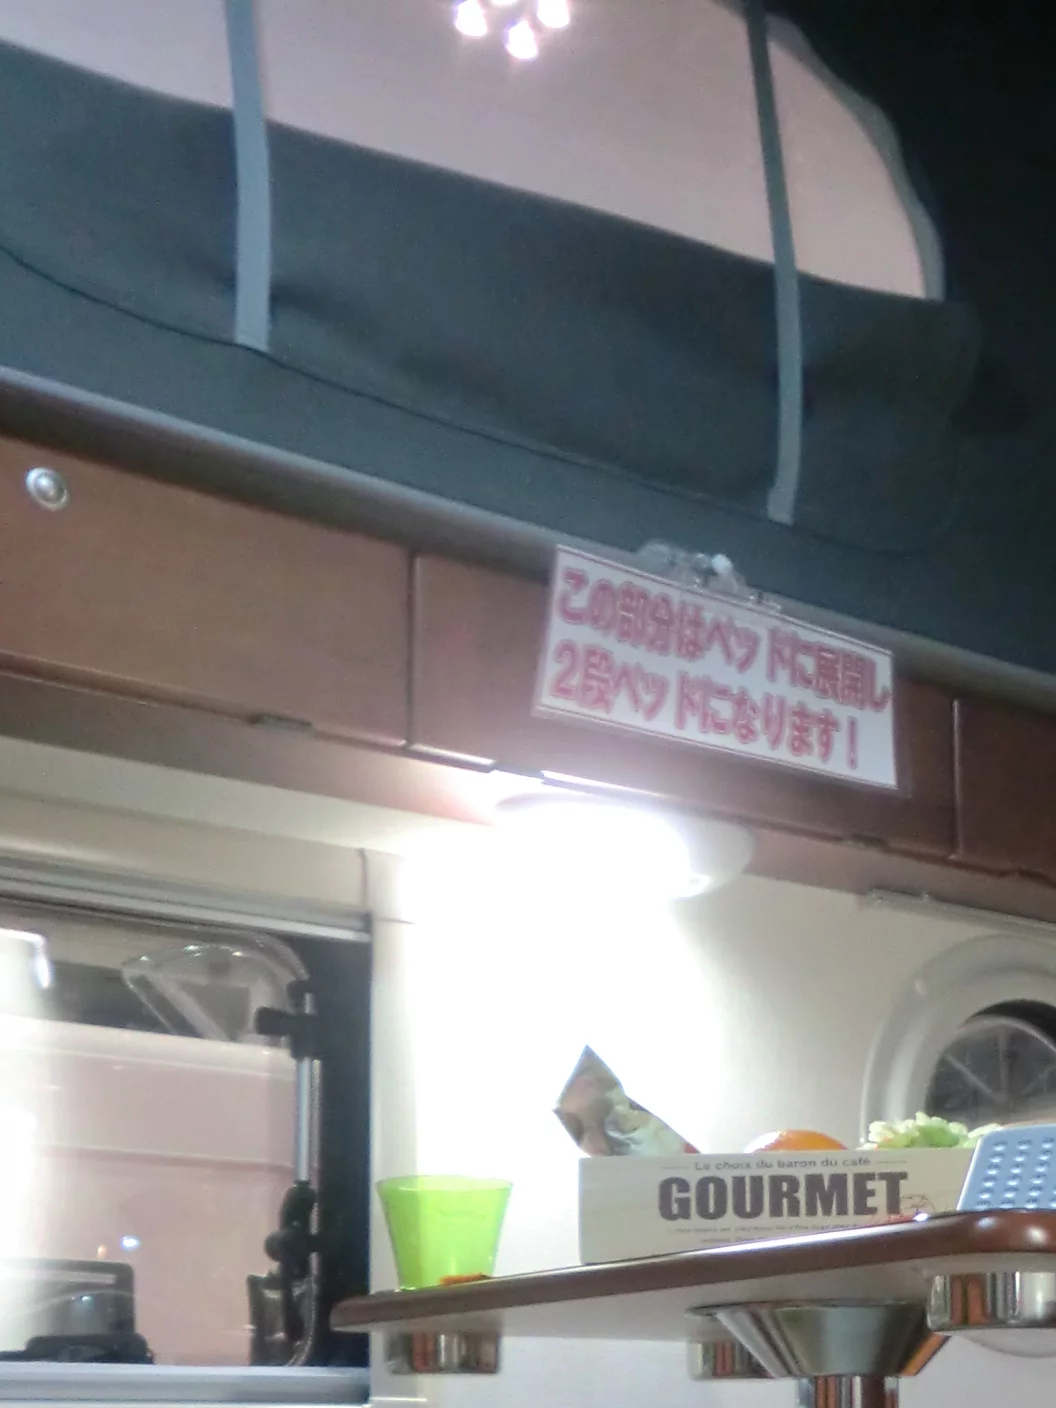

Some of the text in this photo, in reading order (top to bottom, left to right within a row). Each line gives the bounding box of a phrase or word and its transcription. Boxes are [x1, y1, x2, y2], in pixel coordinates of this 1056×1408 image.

[756, 1159, 773, 1169] du
[777, 1157, 816, 1168] baron
[821, 1156, 838, 1166] du
[659, 1172, 908, 1220] GOURMET
